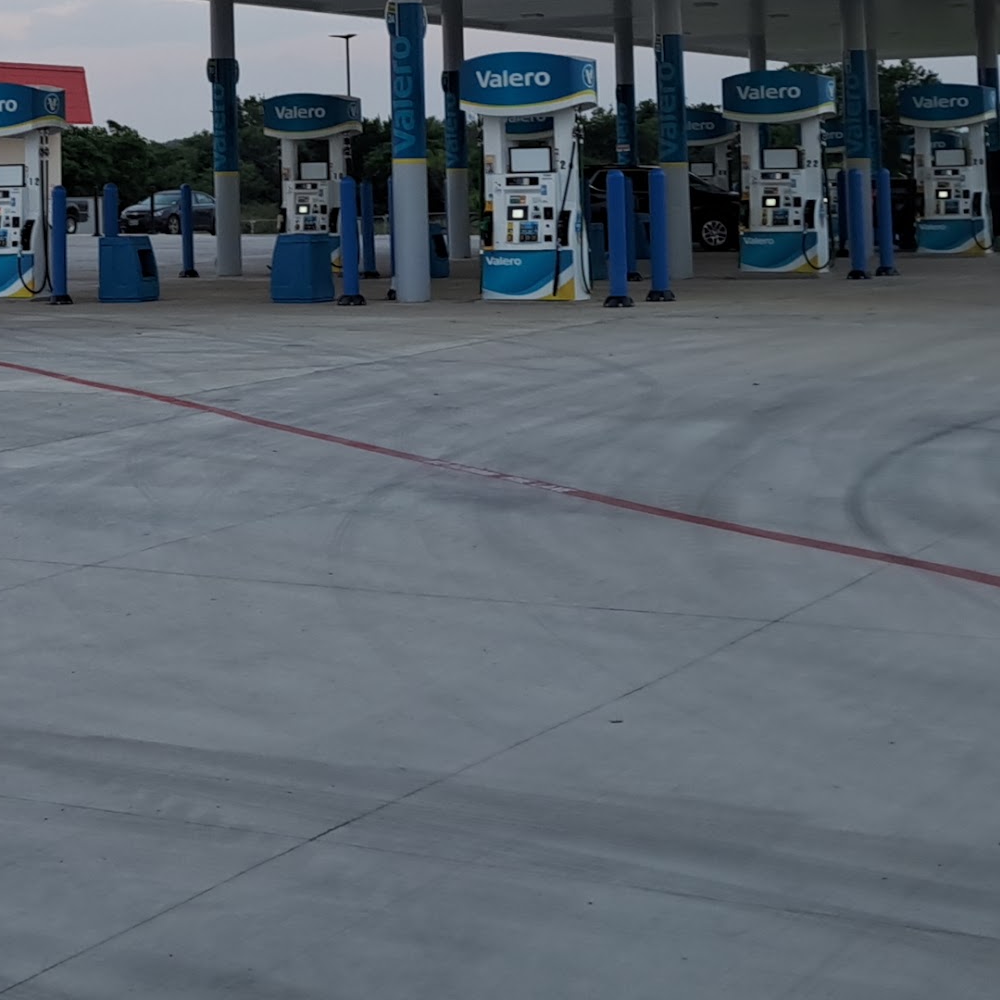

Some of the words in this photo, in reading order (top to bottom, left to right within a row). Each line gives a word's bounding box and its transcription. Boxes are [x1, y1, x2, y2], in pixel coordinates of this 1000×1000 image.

[475, 69, 552, 89] Valero
[393, 34, 417, 156] Valero
[736, 84, 802, 101] Valero
[911, 94, 970, 109] Valero
[274, 105, 326, 121] Valero
[658, 61, 679, 161] Valero
[805, 159, 819, 168] 22
[28, 177, 40, 187] 12
[742, 236, 776, 246] Valero
[485, 256, 522, 268] Valero
